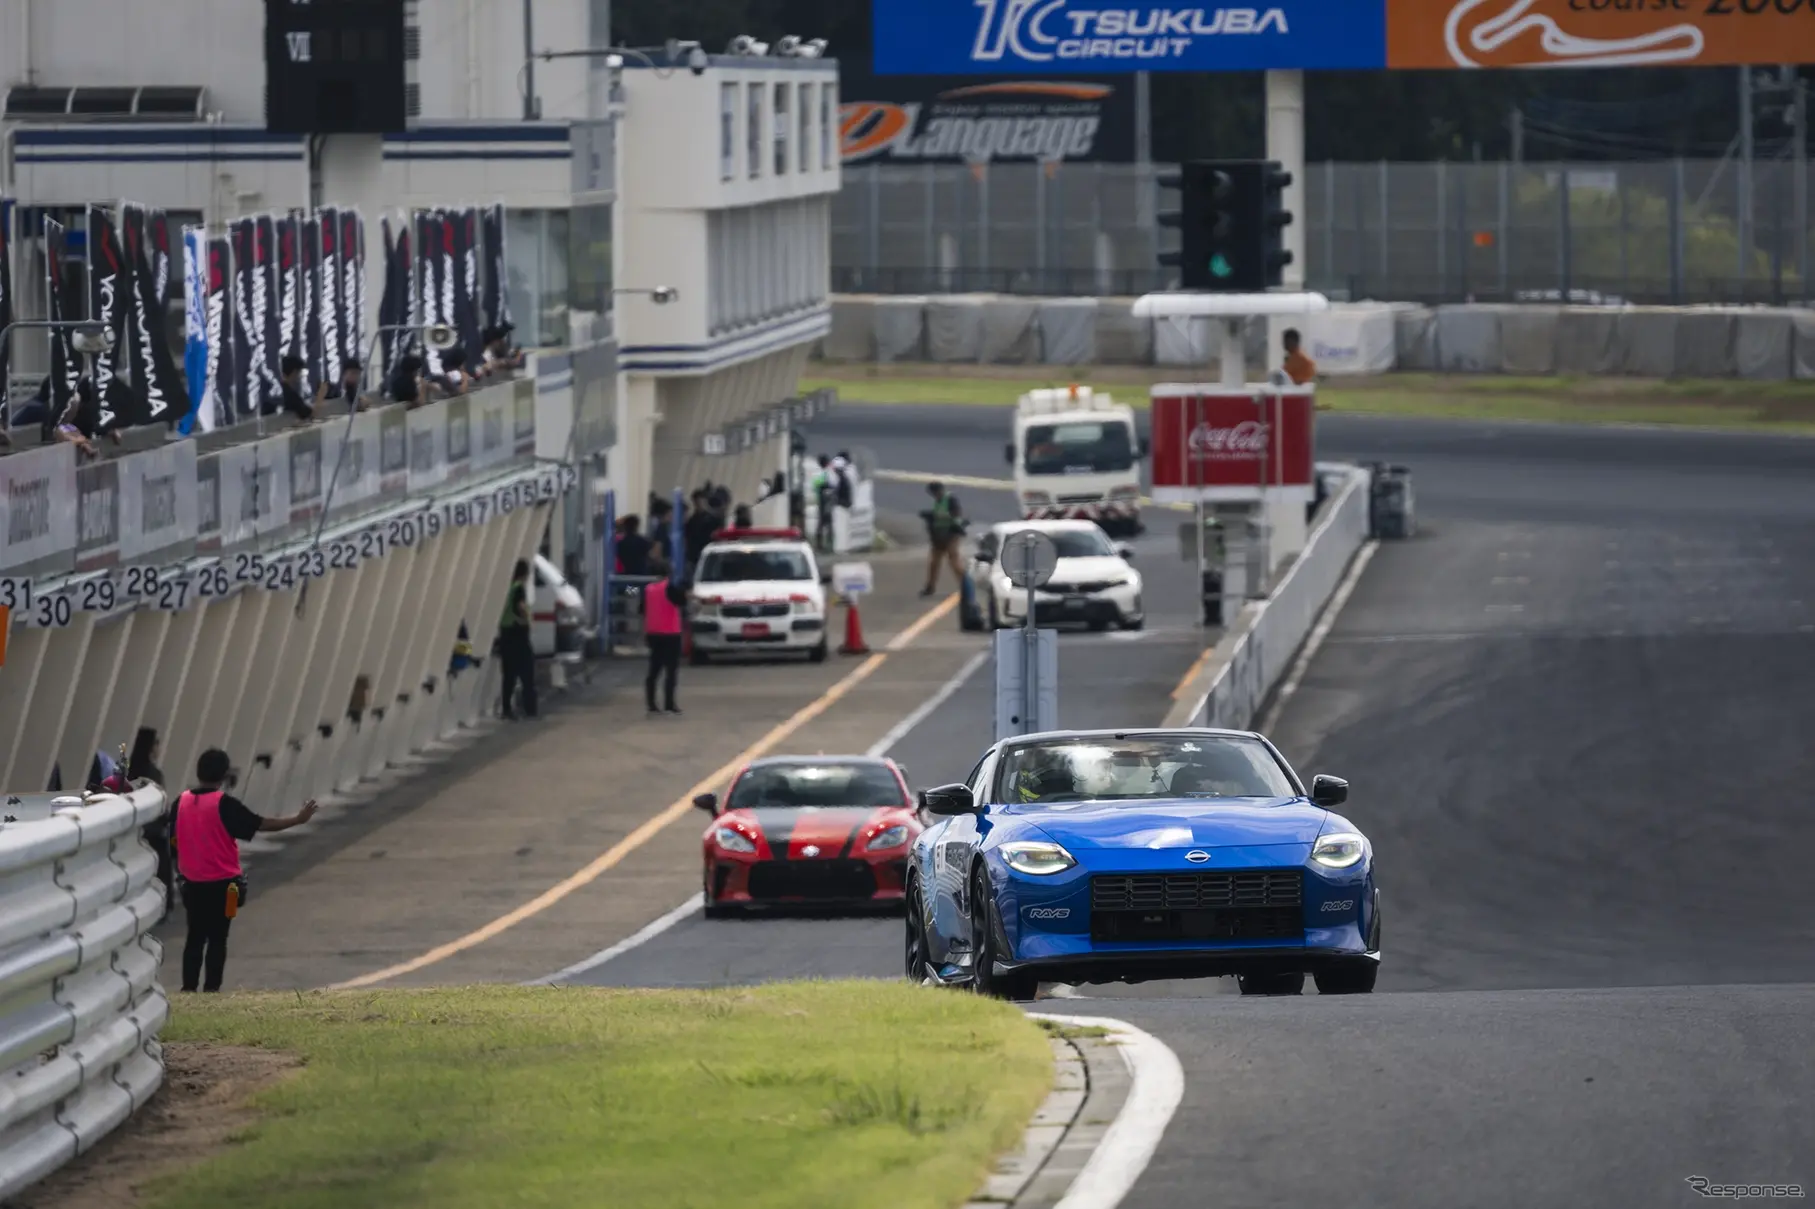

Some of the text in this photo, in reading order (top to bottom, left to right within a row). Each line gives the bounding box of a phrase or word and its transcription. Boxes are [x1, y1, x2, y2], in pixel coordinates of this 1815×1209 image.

[1066, 9, 1290, 36] TSUKUBA
[445, 504, 468, 528] 18
[468, 500, 488, 526] 17
[493, 493, 514, 514] 16
[388, 521, 414, 546] 20
[417, 513, 441, 538] 19
[330, 544, 356, 569] 22
[361, 533, 385, 558] 21
[236, 553, 264, 581] 25
[266, 564, 294, 590] 24
[298, 552, 325, 577] 23
[126, 567, 159, 596] 28
[198, 566, 229, 596] 26
[0, 578, 31, 611] 31
[82, 580, 115, 611] 29
[158, 581, 189, 609] 27
[37, 596, 71, 628] 30
